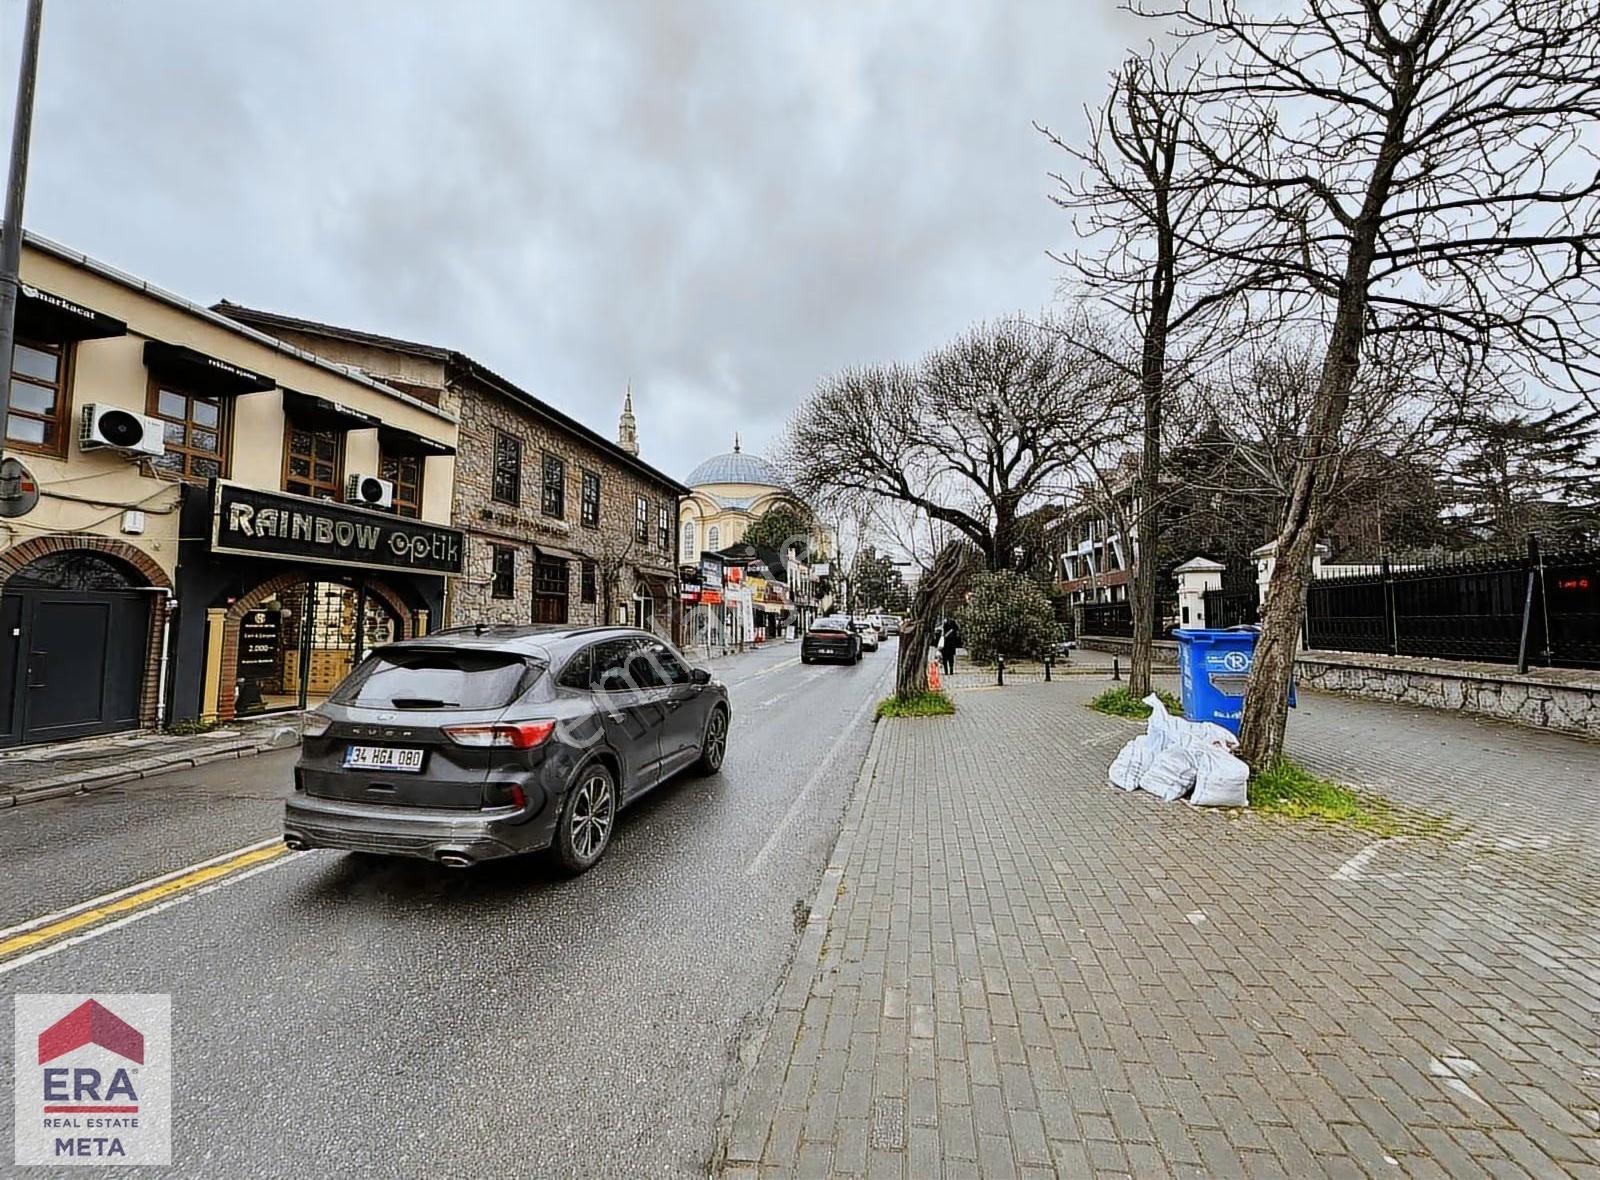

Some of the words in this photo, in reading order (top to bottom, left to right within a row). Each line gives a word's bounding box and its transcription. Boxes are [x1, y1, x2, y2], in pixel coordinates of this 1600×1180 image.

[229, 502, 381, 550] RAINBOW
[388, 532, 459, 563] optik
[353, 747, 367, 763] 34
[372, 748, 394, 765] HGA
[398, 750, 421, 766] 080
